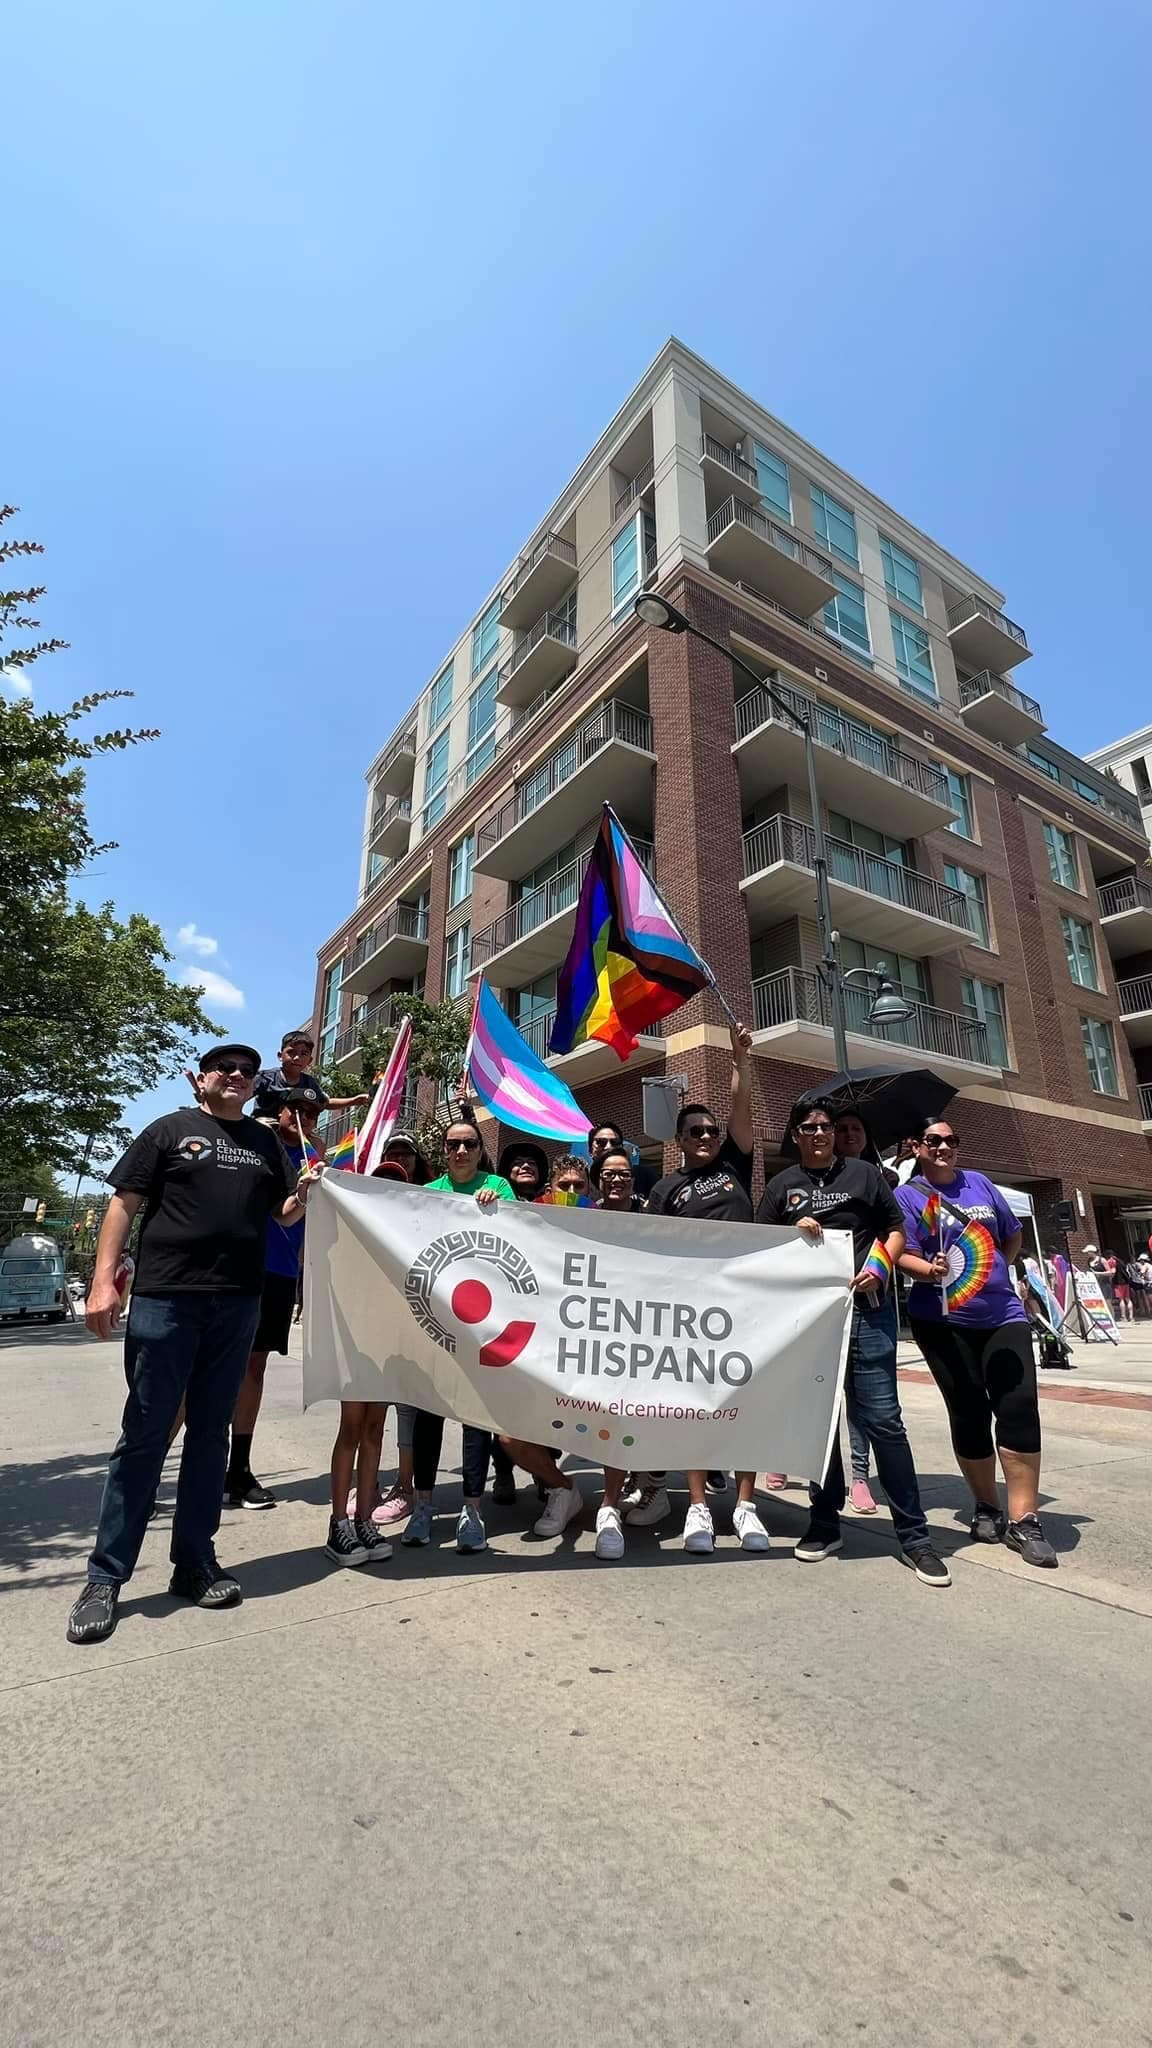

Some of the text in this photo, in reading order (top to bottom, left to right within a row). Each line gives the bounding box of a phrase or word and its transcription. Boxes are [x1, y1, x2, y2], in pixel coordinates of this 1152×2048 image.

[215, 1138, 228, 1147] EL
[216, 1146, 257, 1158] CENTRO
[216, 1153, 262, 1166] HISPANO
[811, 1192, 849, 1201] CENTRO
[562, 1252, 607, 1289] EL
[558, 1294, 733, 1342] CENTRO
[556, 1337, 753, 1387] HISPANO
[555, 1396, 739, 1421] www.elcentronc.org
